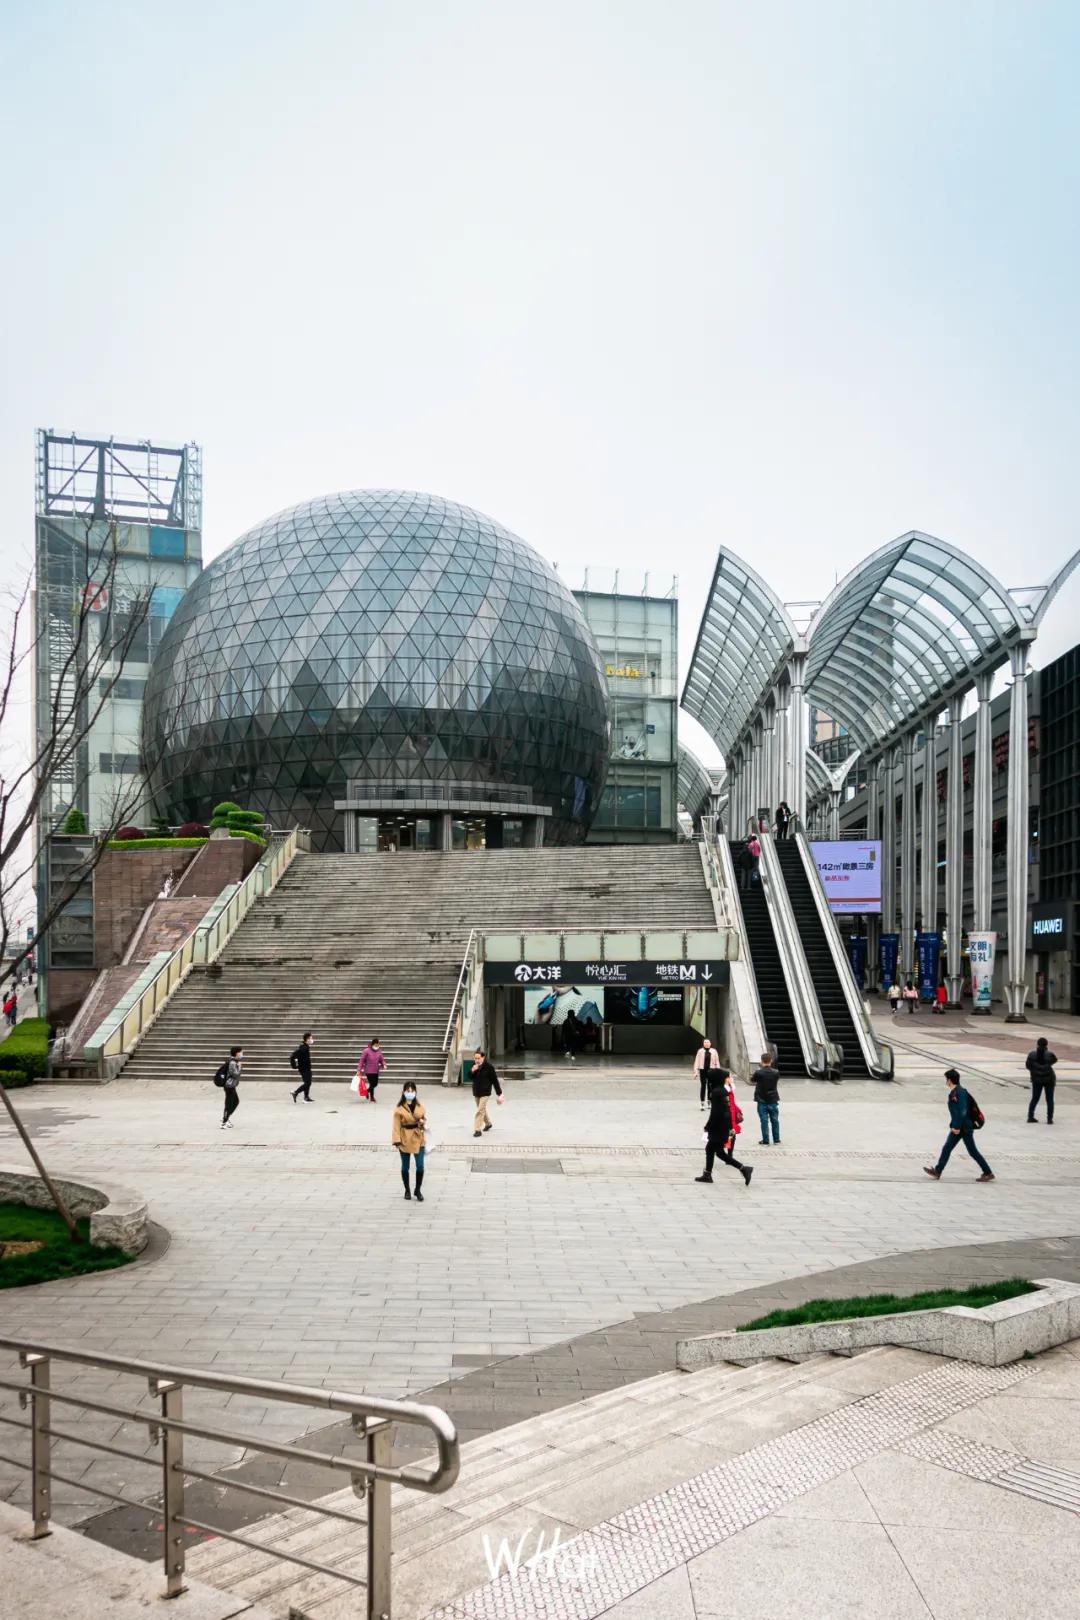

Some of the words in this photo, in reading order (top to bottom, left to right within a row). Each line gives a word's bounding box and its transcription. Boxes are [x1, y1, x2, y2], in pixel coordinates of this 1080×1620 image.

[1033, 918, 1063, 935] HUAWEI
[532, 965, 562, 980] 大洋
[585, 964, 627, 977] 悦心汇
[656, 964, 679, 976] 地铁
